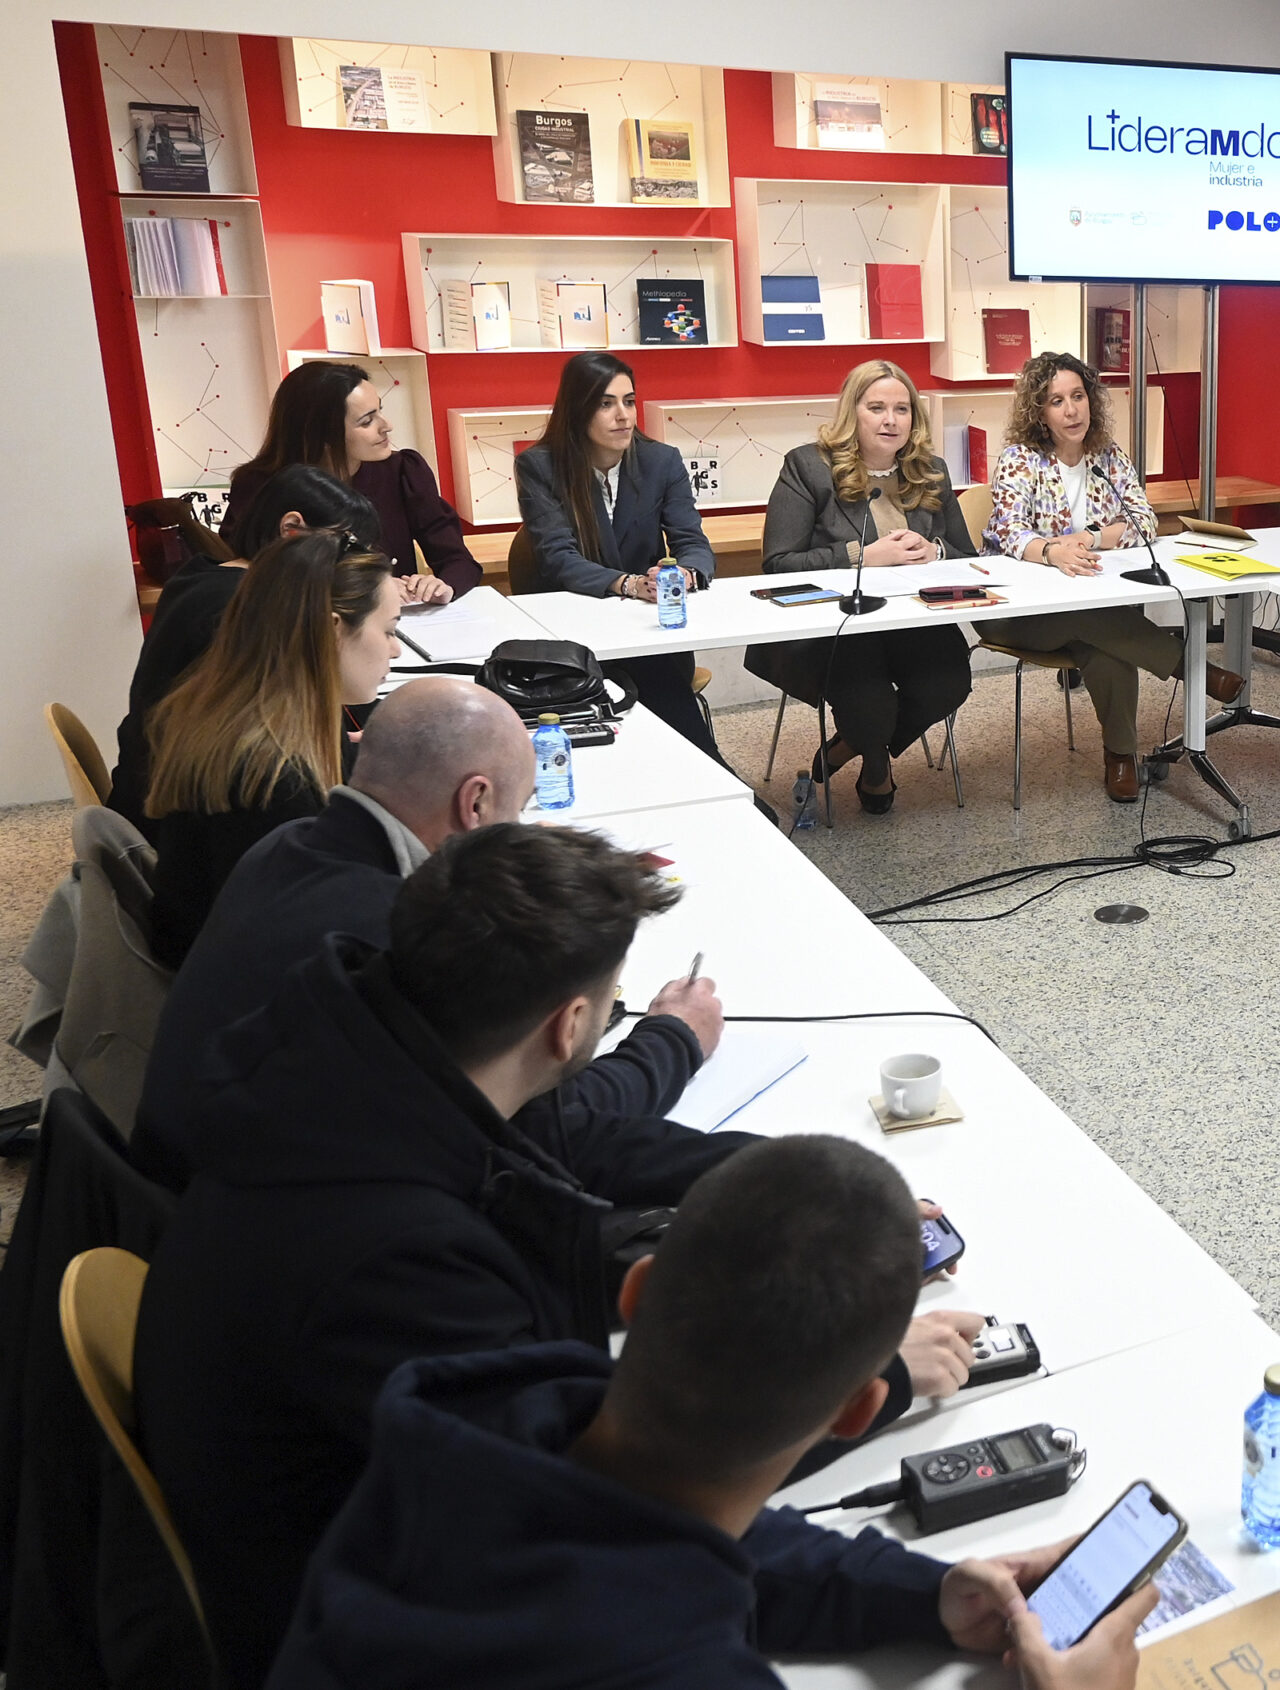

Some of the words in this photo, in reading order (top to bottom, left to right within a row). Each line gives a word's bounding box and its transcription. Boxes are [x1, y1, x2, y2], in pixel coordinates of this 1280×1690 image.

[535, 114, 573, 128] Burgos
[1209, 160, 1244, 176] Mujer
[1247, 164, 1256, 175] e
[1209, 173, 1263, 187] industria
